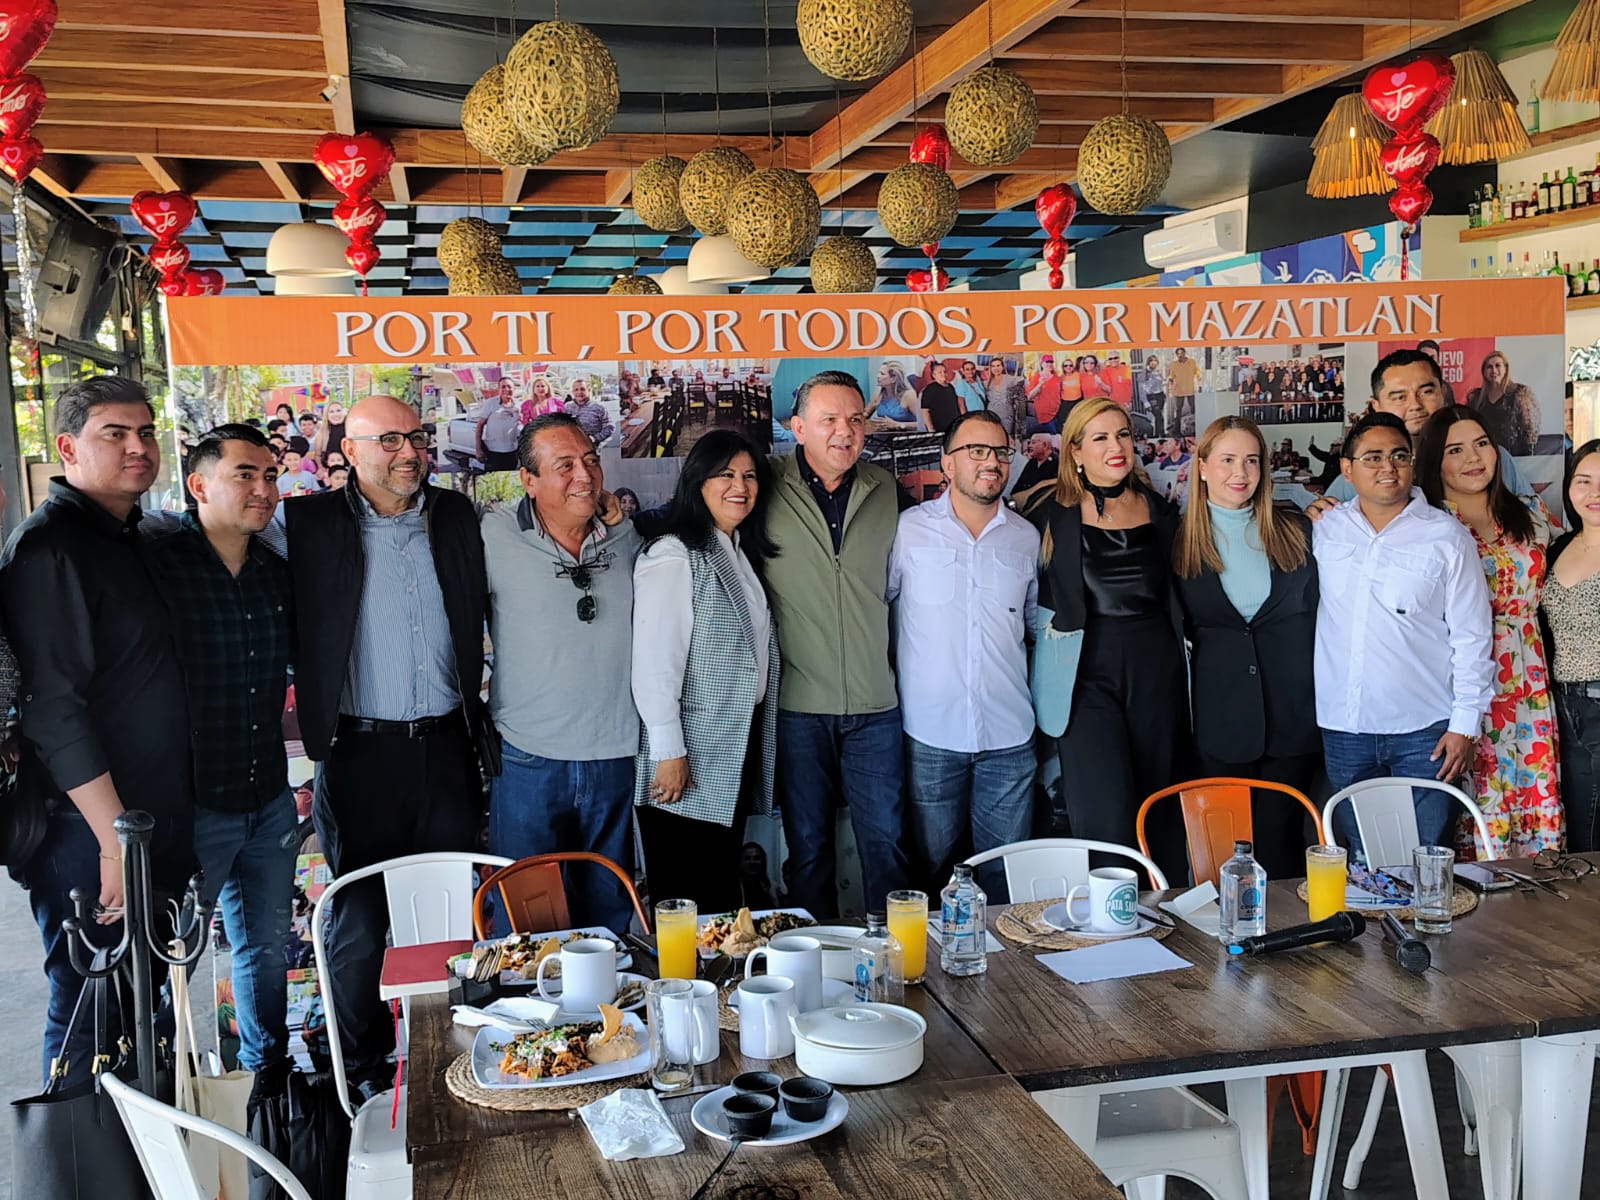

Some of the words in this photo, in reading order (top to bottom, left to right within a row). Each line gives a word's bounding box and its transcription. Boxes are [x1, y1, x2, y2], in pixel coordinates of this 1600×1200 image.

[1385, 141, 1428, 175] Amo
[335, 311, 476, 357] POR
[491, 311, 552, 356] TI
[616, 309, 746, 354] POR
[759, 306, 989, 352] TODOS,
[1013, 303, 1132, 346] POR
[1148, 293, 1441, 342] MAZATLAN
